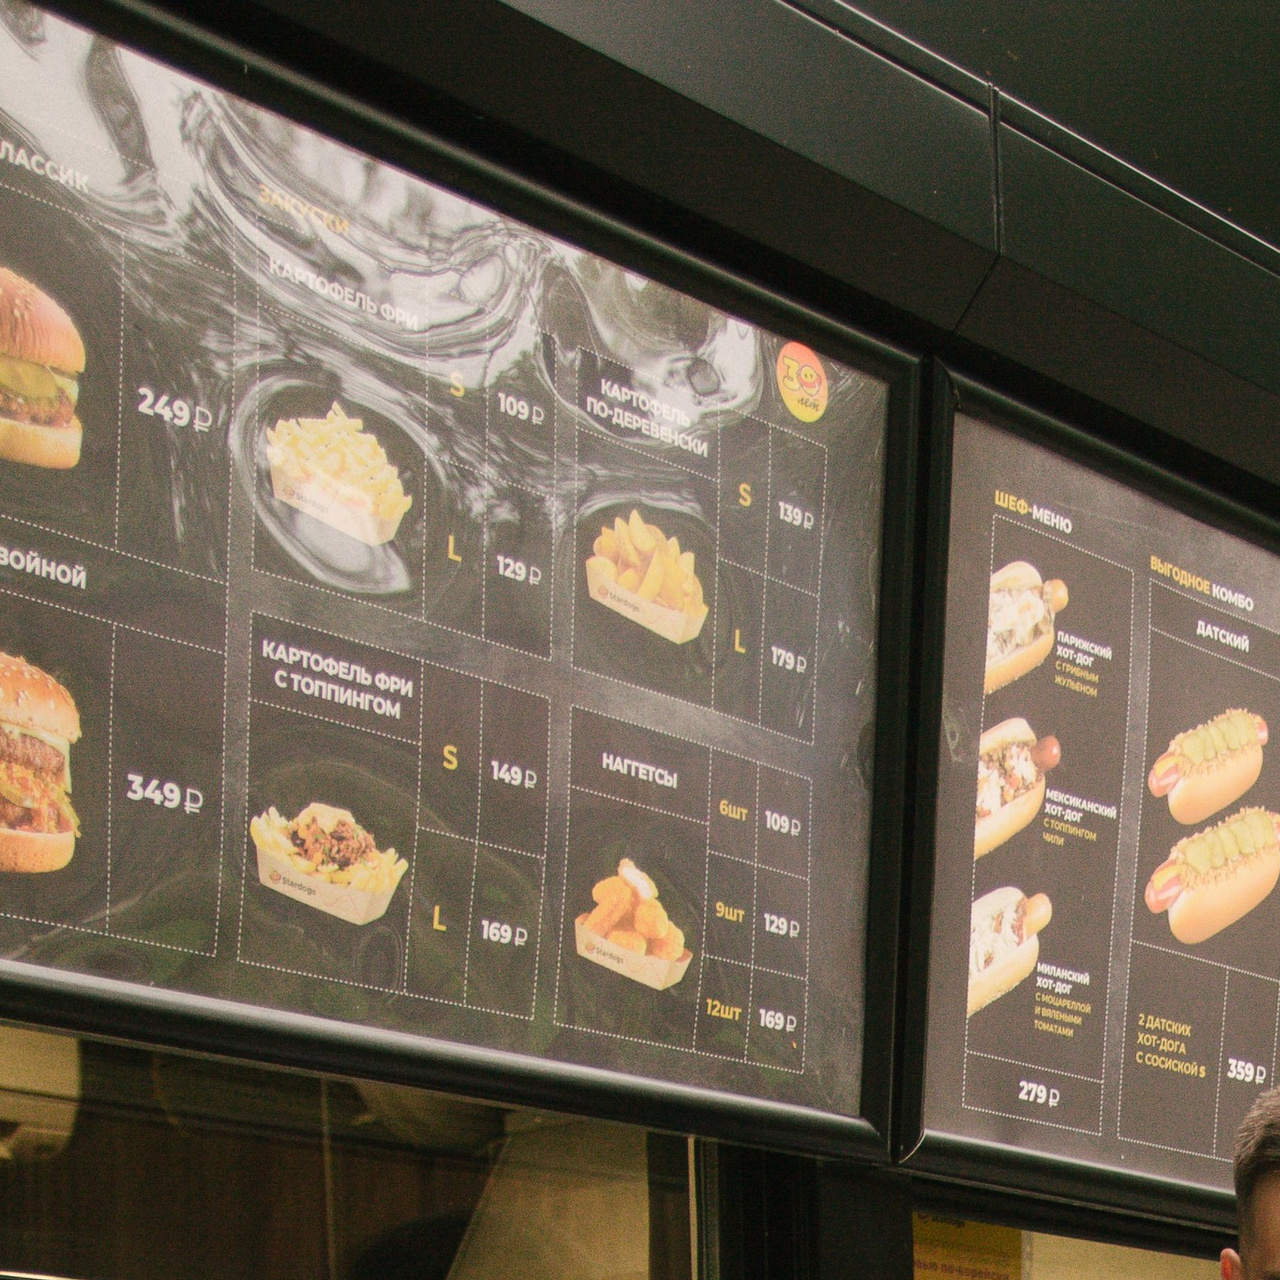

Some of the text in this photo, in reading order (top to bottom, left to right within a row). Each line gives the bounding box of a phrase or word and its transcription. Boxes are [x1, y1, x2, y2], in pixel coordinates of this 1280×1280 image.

[258, 183, 350, 236] ЗАКУСКИ
[269, 256, 419, 331] КАРТОФЕЛЬ ФРИ
[450, 372, 465, 397] S
[600, 378, 691, 428] КАРТОФЕЛЬ
[586, 396, 709, 457] ПО-ДЕРЕВЕНСКИ
[738, 482, 752, 507] S
[994, 489, 1072, 534] ШЕФ-МЕНЮ
[447, 535, 462, 562] L
[1150, 554, 1254, 612] ВЫГОДНОЕ КОМБО
[734, 628, 746, 654] L
[1056, 630, 1113, 660] ПАРИЖСКИЙ
[1196, 619, 1250, 652] ДАТСКИЙ
[262, 639, 413, 698] КАРТОФЕЛЬ ФРИ
[1056, 645, 1095, 668] ХОТ-ДОГ
[1062, 662, 1099, 683] ГРИБНЫМ
[274, 669, 401, 719] С ТОППИНГОМ
[1054, 674, 1098, 698] ЖУЛЬЕНОМ
[442, 745, 458, 771] S
[601, 752, 678, 789] НАГГЕТСЫ
[1044, 802, 1083, 823] ХОТ-ДОГ
[1045, 787, 1117, 820] МЕКСИКАНСКИЙ
[1042, 832, 1064, 847] ЧИЛИ
[1051, 820, 1098, 842] ТОППИНГОМ
[281, 874, 317, 897] Stardogs
[432, 904, 447, 932] L
[1036, 962, 1090, 986] МИЛАНСКИЙ
[1036, 976, 1073, 995] ХОТ-ДОГ
[1042, 993, 1092, 1015] МОЦАРЕЛЛОЙ
[1033, 1019, 1074, 1038] ТОМАТАМИ
[1145, 1015, 1192, 1038] ДАТСКИХ
[1137, 1031, 1187, 1056] ХОТ-ДОГА
[1144, 1053, 1198, 1078] СОСИСКОЙ
